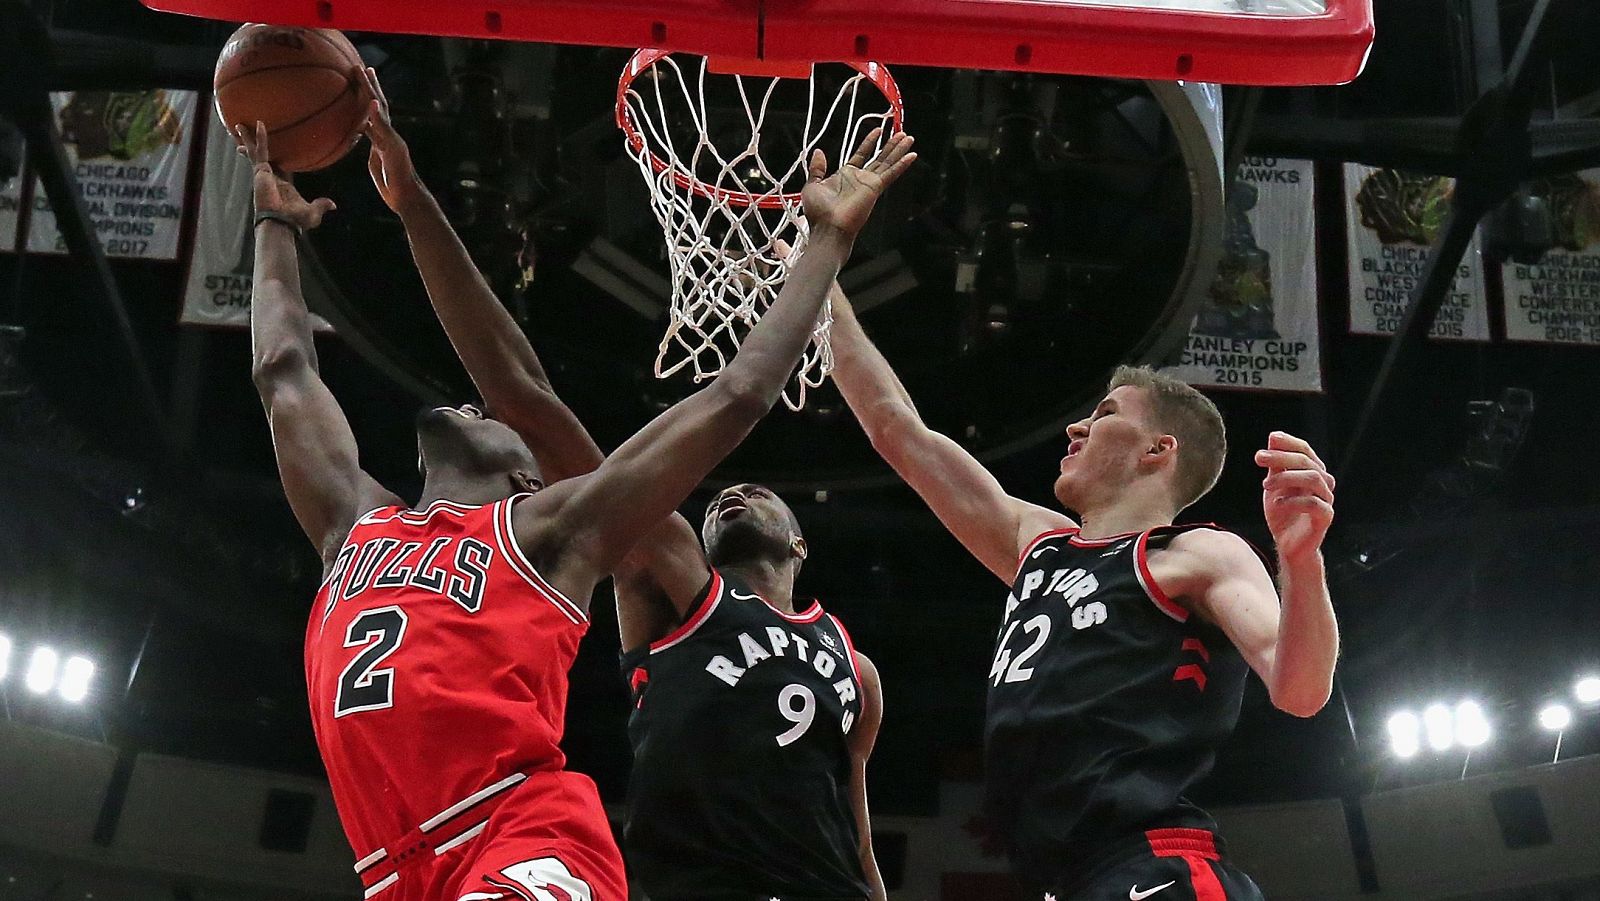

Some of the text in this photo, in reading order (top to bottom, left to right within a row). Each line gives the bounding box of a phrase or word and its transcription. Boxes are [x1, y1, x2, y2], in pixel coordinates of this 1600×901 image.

[77, 163, 150, 181] CHICAGO
[78, 182, 168, 200] CKHAWKS
[1382, 246, 1427, 262] CHICA
[1531, 281, 1600, 299] WESTER
[1528, 311, 1600, 327] CHAMPIO
[1183, 336, 1308, 356] TANLEY CUP
[1180, 351, 1299, 372] CHAMPIONS
[1215, 369, 1263, 385] 2015
[988, 614, 1052, 688] 42
[334, 605, 408, 718] 2
[705, 626, 856, 735] RAPTORS
[776, 683, 816, 747] 9
